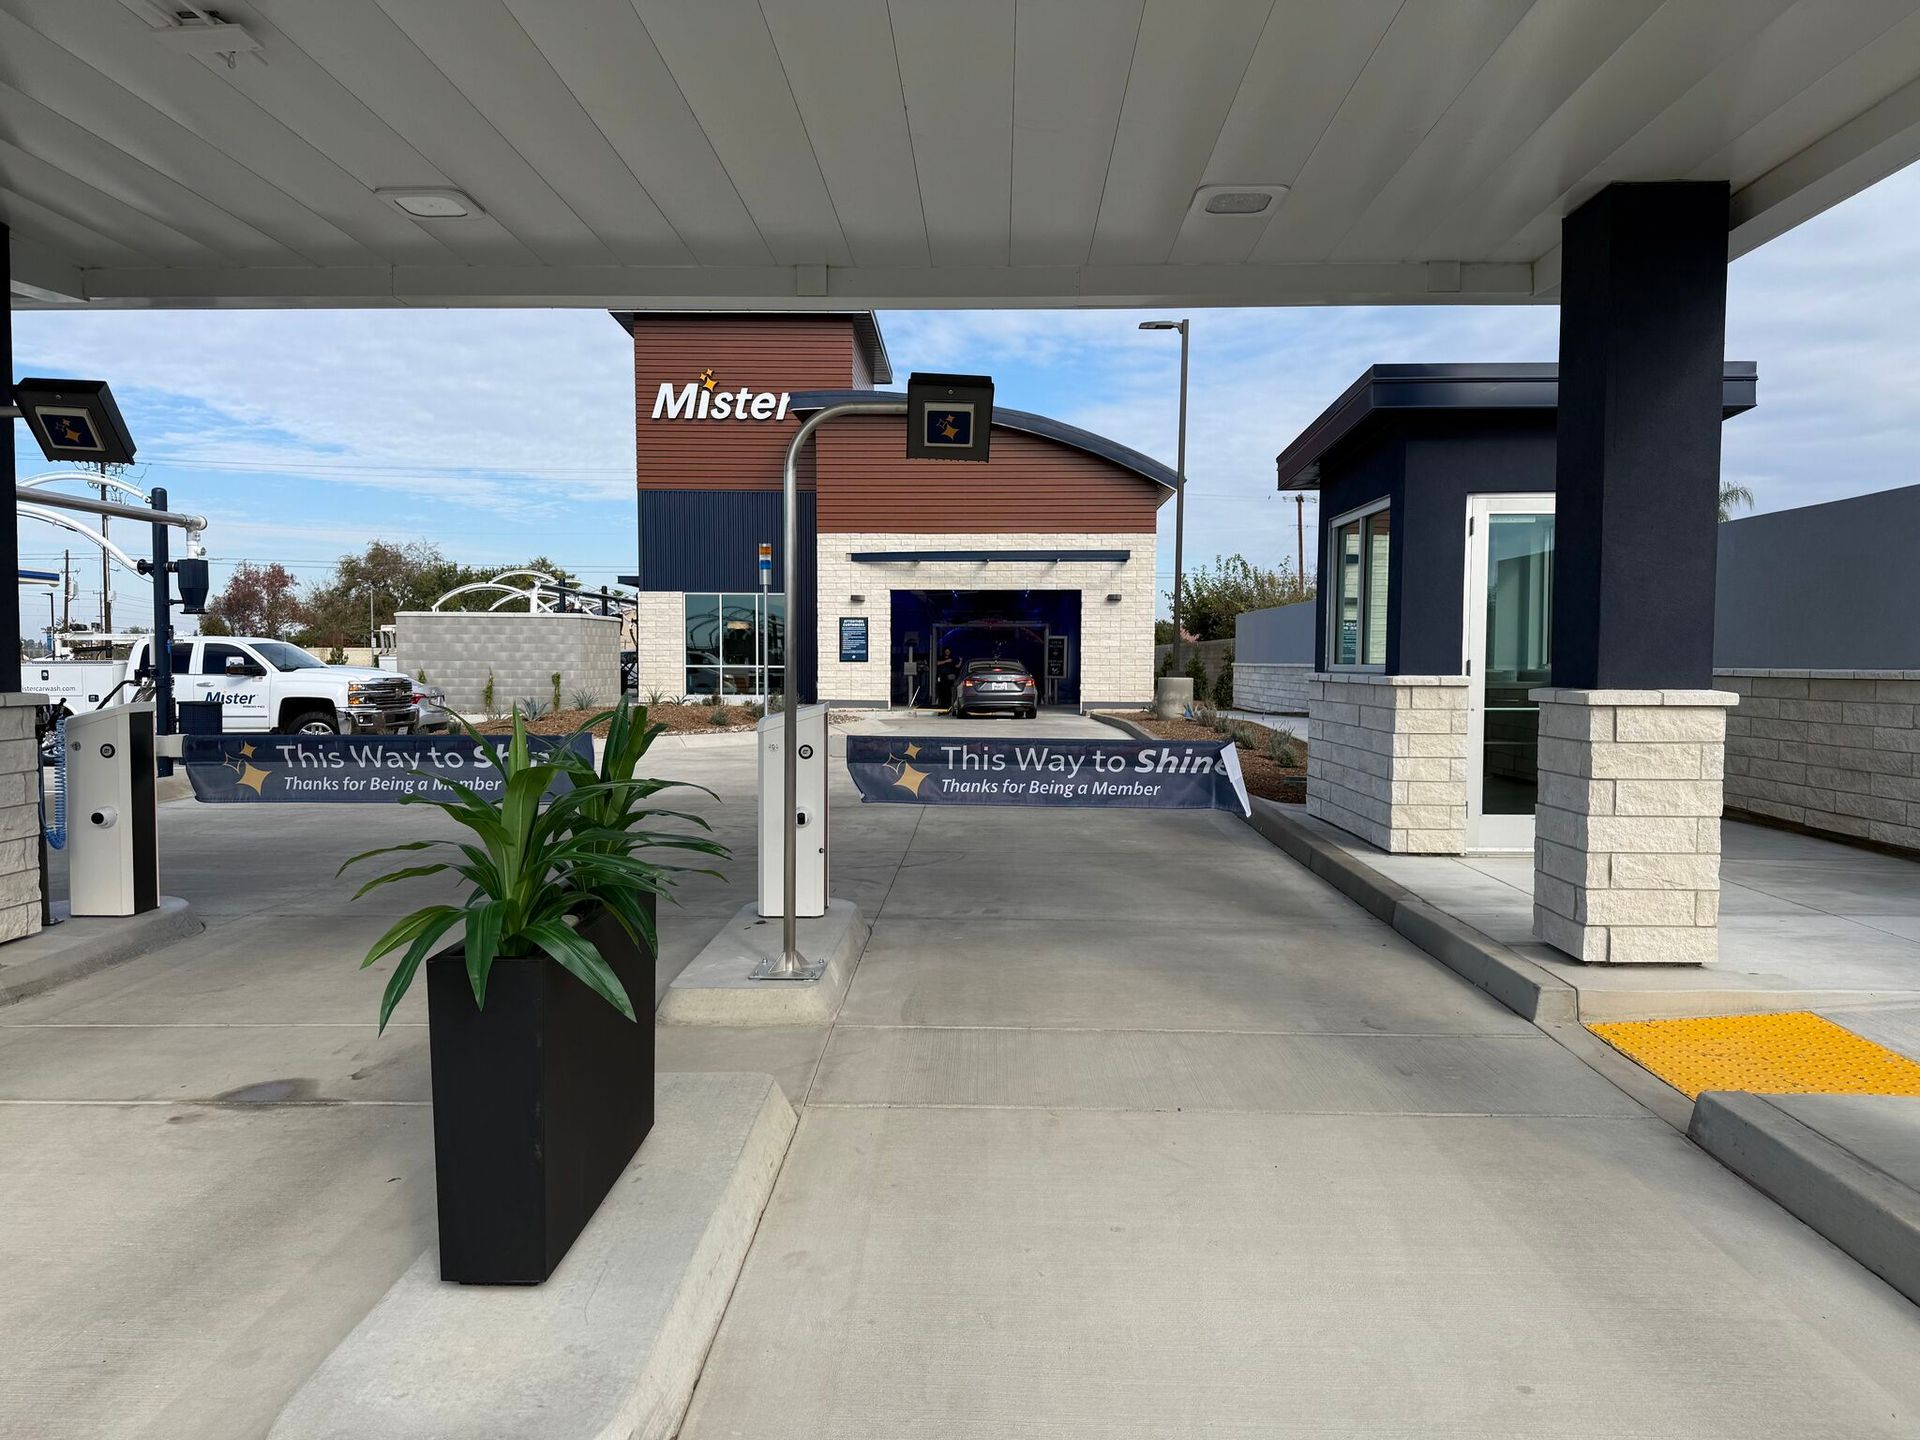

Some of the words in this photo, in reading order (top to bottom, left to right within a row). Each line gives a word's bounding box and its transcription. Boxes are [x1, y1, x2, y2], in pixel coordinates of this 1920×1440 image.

[652, 383, 790, 420] Mister
[21, 684, 76, 692] istercarwash.com
[205, 692, 256, 705] Mister
[275, 743, 345, 768] This
[349, 745, 421, 775] Way
[427, 747, 464, 769] to
[940, 745, 1006, 771] This
[1015, 747, 1086, 778] Way
[1095, 749, 1126, 773] to
[1135, 748, 1229, 776] Shine
[284, 776, 339, 790] Thanks
[343, 776, 366, 791] for
[370, 776, 415, 794] Being
[418, 780, 428, 791] a
[941, 778, 999, 793] Thanks
[1002, 778, 1026, 794] for
[1029, 779, 1075, 797] Being
[1078, 784, 1088, 795] a
[1092, 781, 1161, 796] Member
